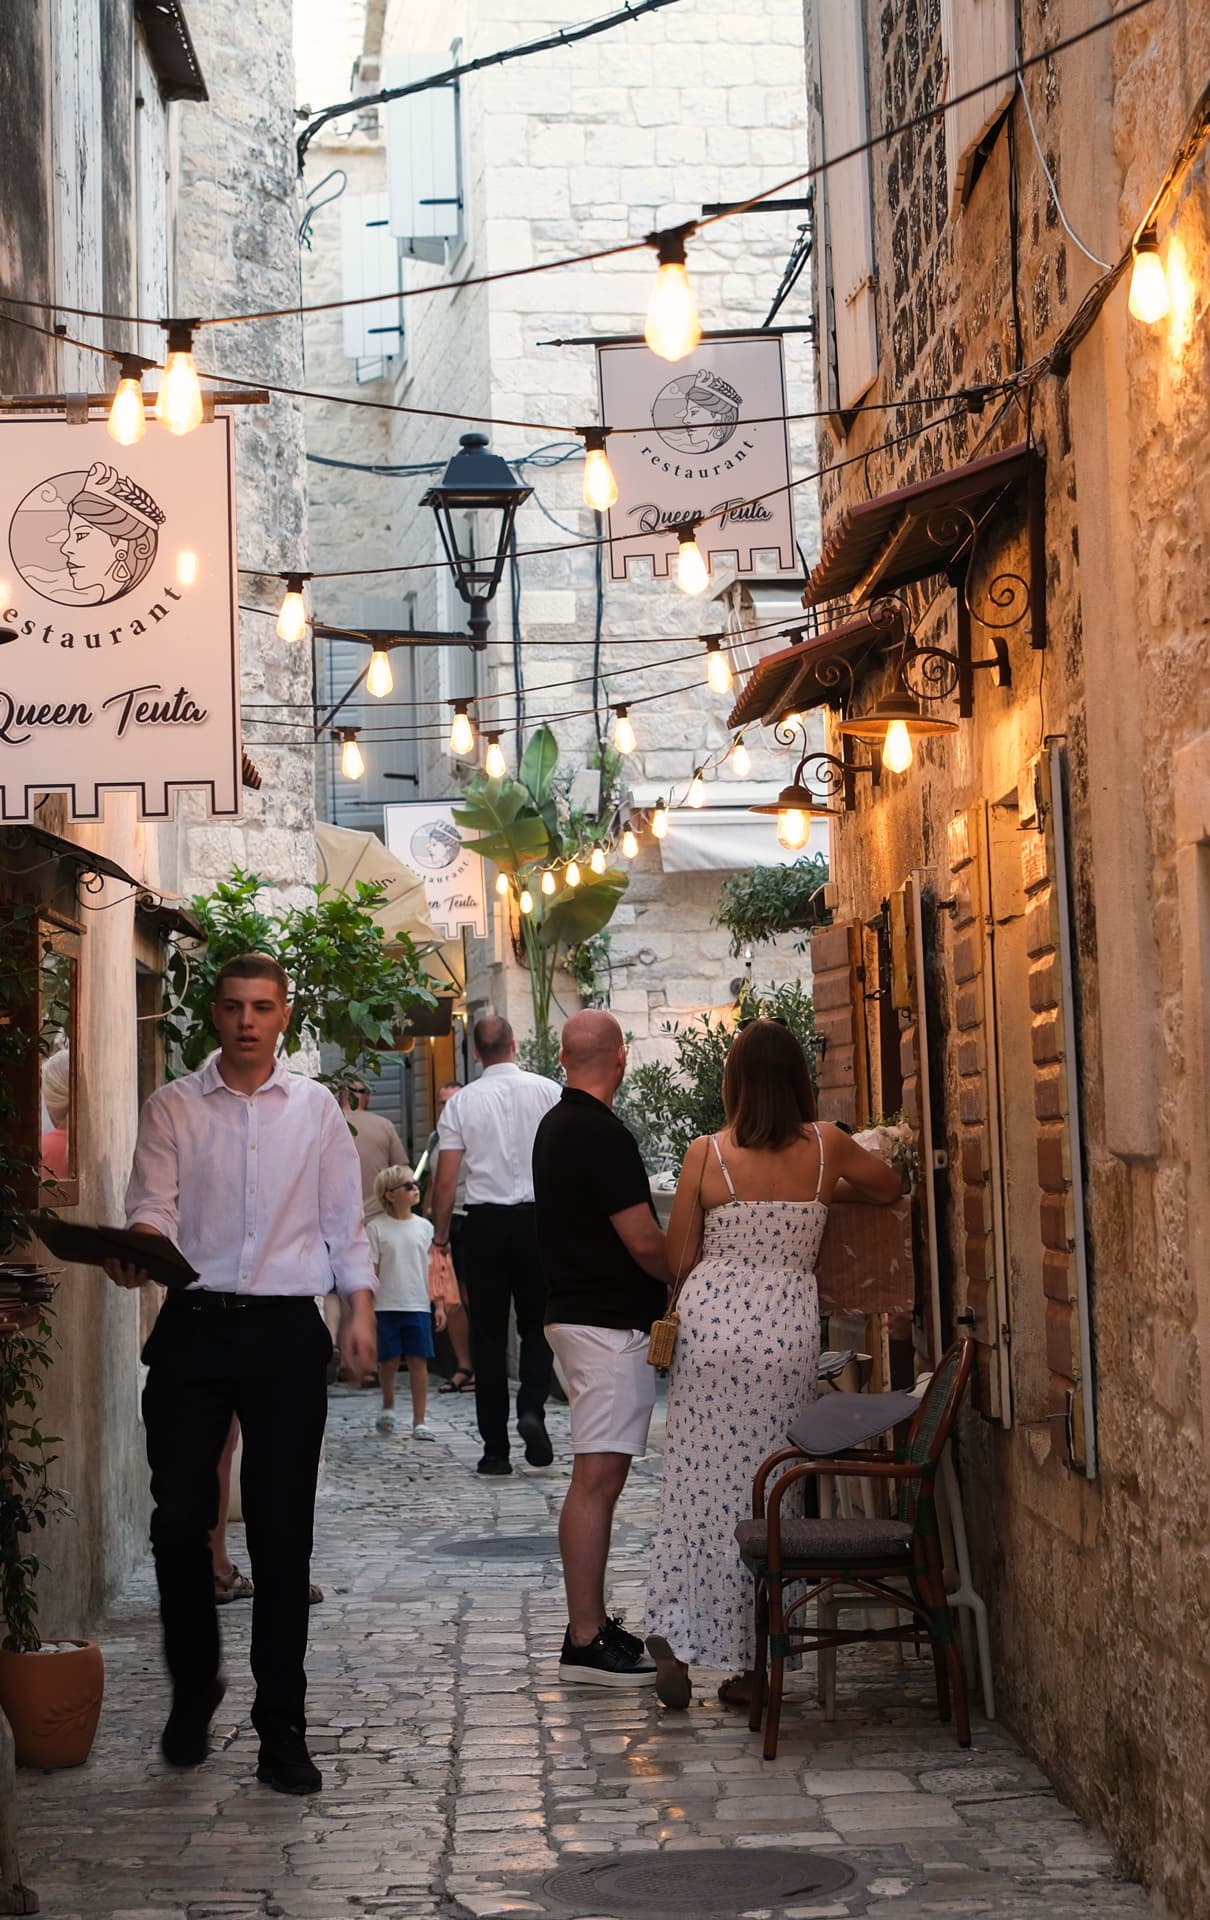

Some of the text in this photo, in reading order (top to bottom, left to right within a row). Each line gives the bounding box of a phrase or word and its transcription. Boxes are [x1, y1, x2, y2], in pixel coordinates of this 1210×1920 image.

[640, 439, 754, 479] restaurant
[710, 497, 771, 529] Teuta
[2, 586, 182, 649] estaurant
[102, 683, 207, 738] Teuta
[406, 861, 469, 883] taurant
